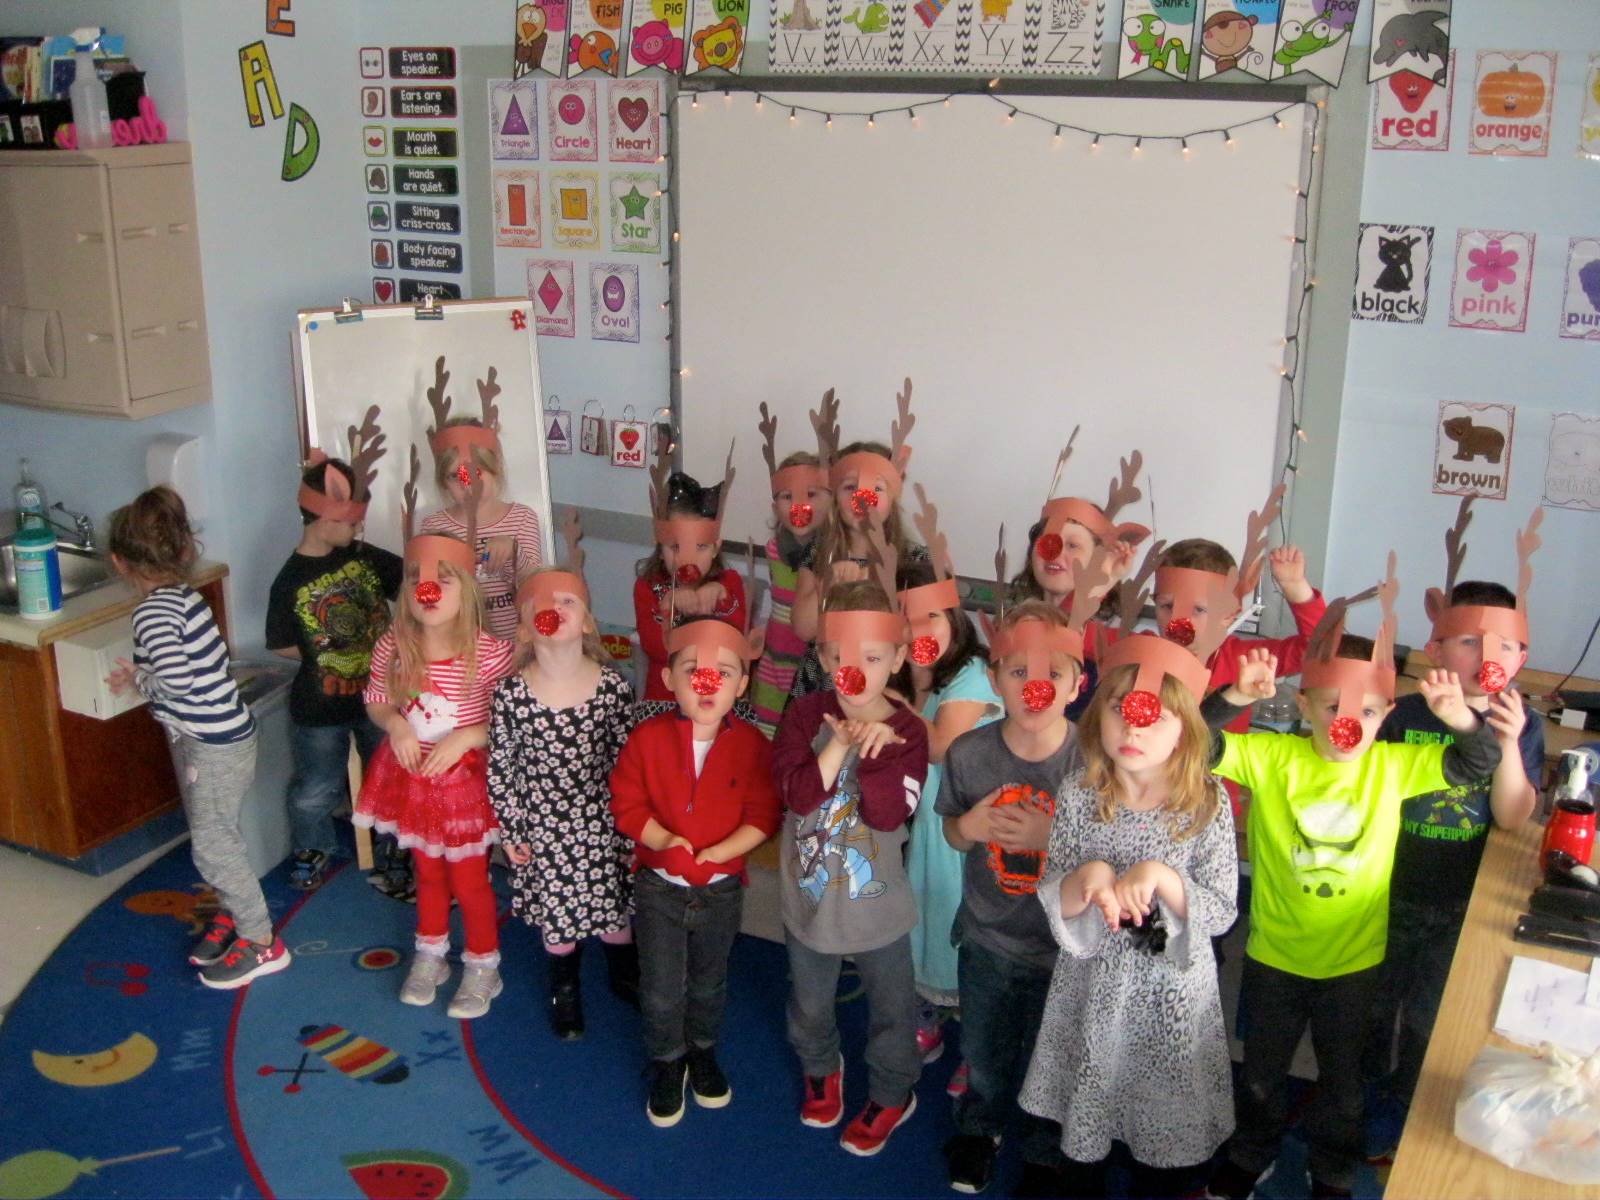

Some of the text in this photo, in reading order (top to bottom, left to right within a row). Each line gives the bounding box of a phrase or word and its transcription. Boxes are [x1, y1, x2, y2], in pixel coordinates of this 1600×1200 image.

[402, 51, 438, 62] Eyes on
[401, 64, 441, 76] speaker.
[401, 90, 442, 101] Ears are
[401, 103, 442, 115] listening.
[1381, 110, 1438, 138] red
[407, 131, 437, 142] Mouth
[1475, 123, 1543, 142] orange
[501, 139, 531, 149] Triangle
[554, 135, 591, 149] Circle
[616, 137, 652, 150] Heart
[404, 145, 440, 157] is quiet.
[408, 168, 435, 180] Hands
[403, 182, 445, 194] are quiet.
[412, 206, 440, 220] Sitting
[401, 218, 454, 231] criss-cross.
[621, 223, 651, 239] Star
[403, 243, 456, 258] Body facing
[410, 257, 449, 269] speaker.
[417, 283, 443, 295] Heart
[1361, 292, 1421, 315] black
[1461, 293, 1516, 316] pink
[601, 314, 630, 328] Oval
[616, 450, 641, 462] red
[1437, 464, 1501, 489] brown
